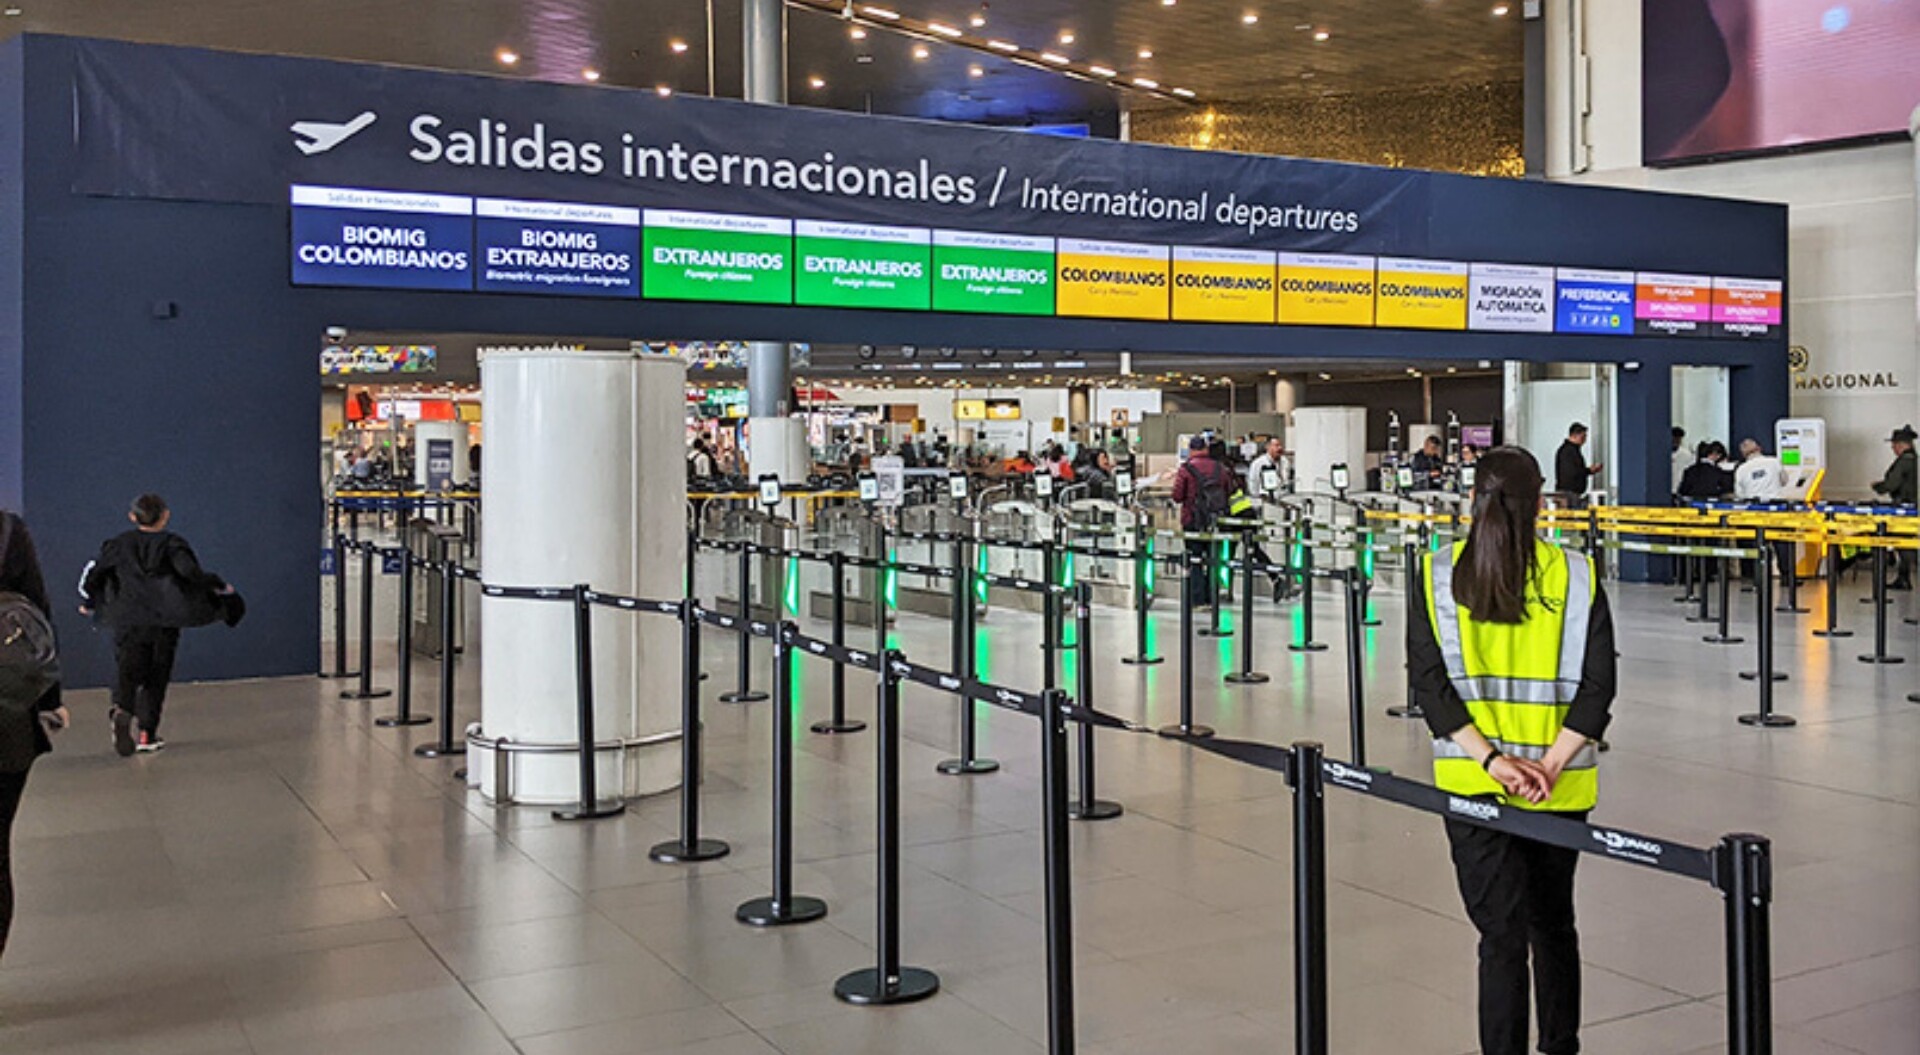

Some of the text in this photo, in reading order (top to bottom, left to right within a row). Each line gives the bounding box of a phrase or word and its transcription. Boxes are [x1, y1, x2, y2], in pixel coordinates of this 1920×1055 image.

[409, 112, 1359, 236] Salidas internacionales / International departures
[342, 225, 426, 247] BIOMIG
[521, 229, 598, 250] BIOMIG
[299, 244, 468, 271] COLOMBIANOS
[486, 247, 631, 272] EXTRANJEROS
[652, 246, 784, 271] EXTRANJEROS
[804, 255, 923, 278] EXTRANJEROS
[941, 263, 1048, 285] EXTRANJEROS
[1061, 267, 1167, 287] COLOMBIANOS
[1175, 273, 1272, 291] COLOMBIANOS
[1281, 278, 1372, 295] COLOMBIANOS
[1380, 283, 1465, 299] COLOMBIANOS
[1480, 285, 1543, 298] MIGRACIÓN
[1560, 288, 1631, 303] PREFERENCIAL
[1795, 372, 1899, 390] NACIONAL
